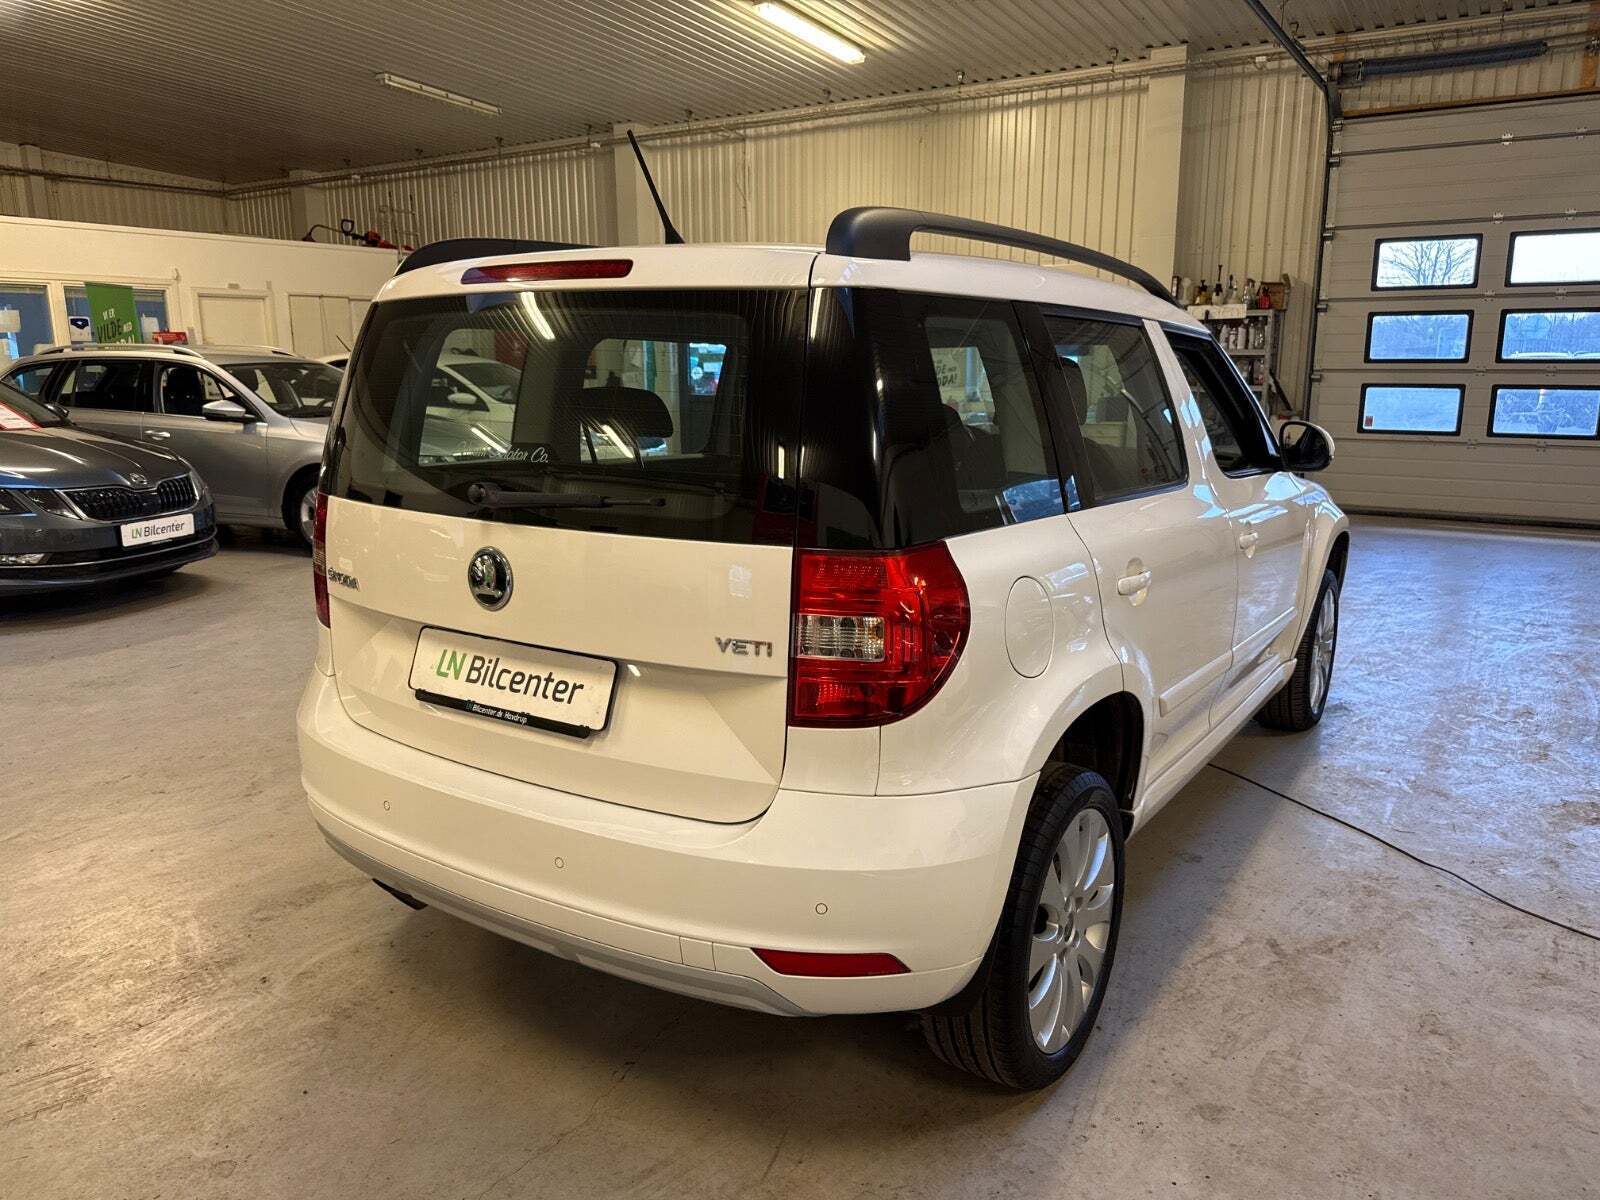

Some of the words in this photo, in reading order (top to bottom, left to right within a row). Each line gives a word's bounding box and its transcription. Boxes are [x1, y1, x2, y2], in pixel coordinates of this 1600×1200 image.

[97, 318, 122, 342] VILDE
[530, 446, 549, 463] Co.
[131, 528, 142, 539] LN
[143, 522, 185, 537] Bilcenter
[436, 649, 467, 681] LN
[465, 655, 585, 705] Bilcenter
